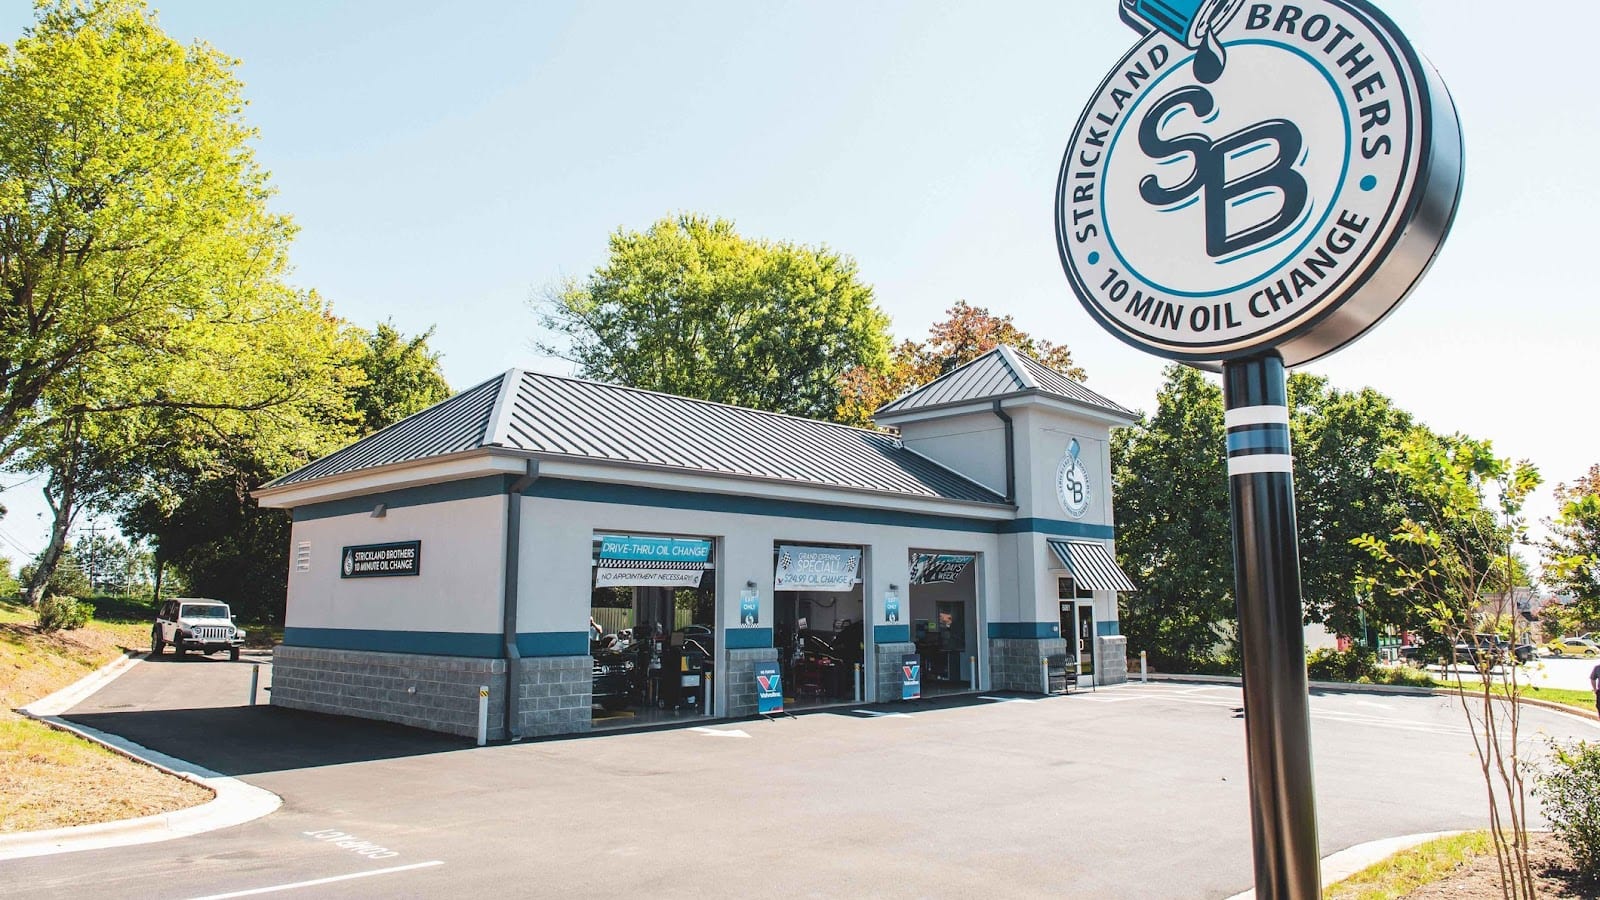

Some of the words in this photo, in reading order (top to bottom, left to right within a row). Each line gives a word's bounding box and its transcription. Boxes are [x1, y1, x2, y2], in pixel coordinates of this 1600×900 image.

[1073, 43, 1169, 243] STRICKLAND
[1245, 4, 1391, 160] BROTHERS
[1100, 267, 1129, 303] 10
[1125, 290, 1184, 331] MIN
[1189, 301, 1242, 332] OIL
[1248, 209, 1369, 318] CHANGE
[354, 550, 386, 562] STRICKLAND
[386, 548, 415, 560] BROTHERS
[602, 542, 656, 554] DRIVE-THRU
[656, 545, 670, 556] OIL
[354, 562, 360, 572] 10
[360, 561, 380, 571] MINUTE
[379, 561, 389, 570] OIL
[389, 559, 413, 570] CHANGE
[601, 572, 612, 580] NO
[612, 572, 657, 581] APPOINTMENT
[807, 574, 820, 584] OIL
[820, 575, 848, 584] CHANGE
